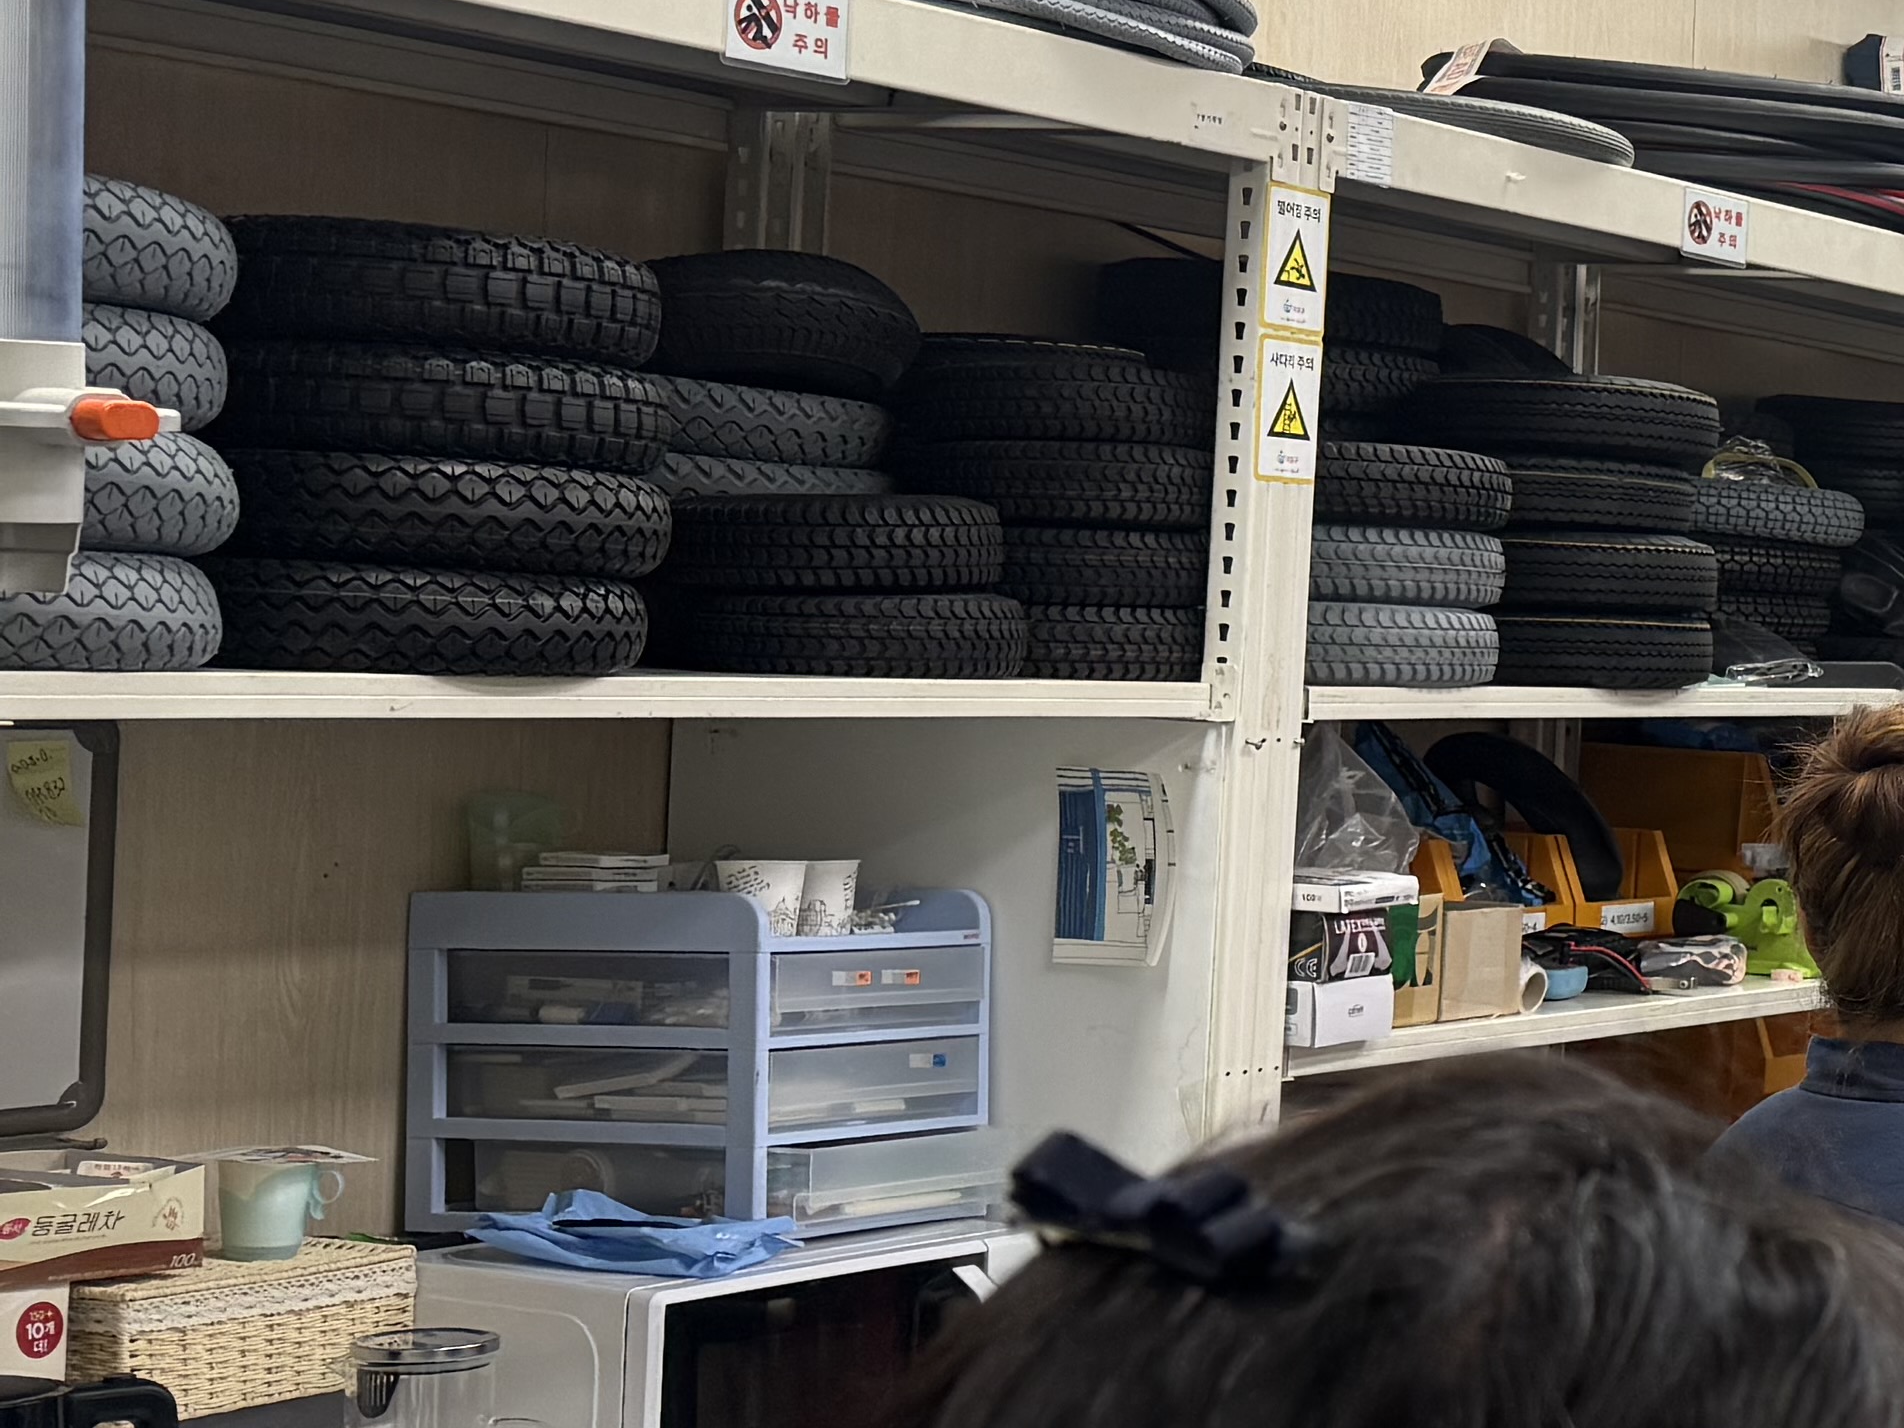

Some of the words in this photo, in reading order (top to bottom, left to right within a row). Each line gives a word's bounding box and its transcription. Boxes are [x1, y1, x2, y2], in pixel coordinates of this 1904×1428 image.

[793, 33, 828, 60] 주의
[1304, 205, 1321, 223] 주의
[1270, 352, 1295, 369] 사다리
[1297, 355, 1314, 371] 주의
[31, 1210, 125, 1237] 둥굴레차
